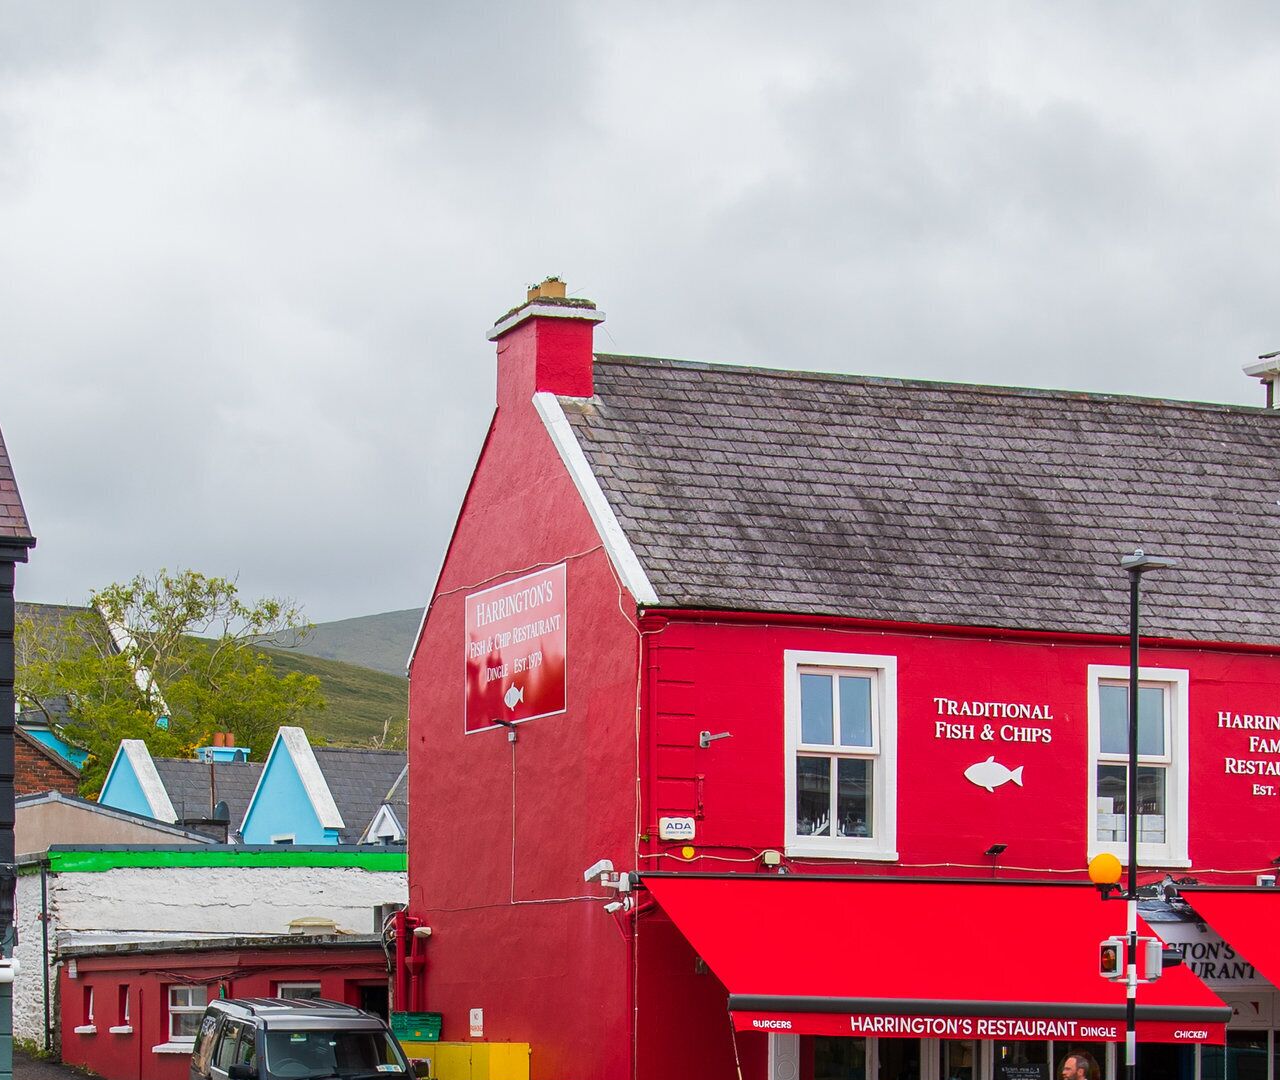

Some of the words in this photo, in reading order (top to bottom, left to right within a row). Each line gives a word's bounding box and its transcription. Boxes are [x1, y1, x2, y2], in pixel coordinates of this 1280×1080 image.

[476, 580, 553, 628] HARRINGTON'S
[470, 640, 486, 659] FISH
[487, 637, 494, 652] &
[495, 631, 512, 650] CHIP
[513, 614, 561, 644] RESTAURANT
[487, 664, 509, 682] DINGLE
[933, 697, 1053, 720] TRADITIONAL
[935, 721, 975, 740] FISH
[980, 723, 995, 741] &
[1000, 724, 1052, 743] CHIPS
[1252, 784, 1277, 796] EST.
[666, 822, 692, 830] ADA
[753, 1019, 792, 1029] BURGERS
[851, 1016, 972, 1035] HARRINGTON'S
[977, 1019, 1078, 1037] RESTAURANT
[1080, 1026, 1117, 1038] DINGLE
[1174, 1030, 1208, 1039] CHICKEN
